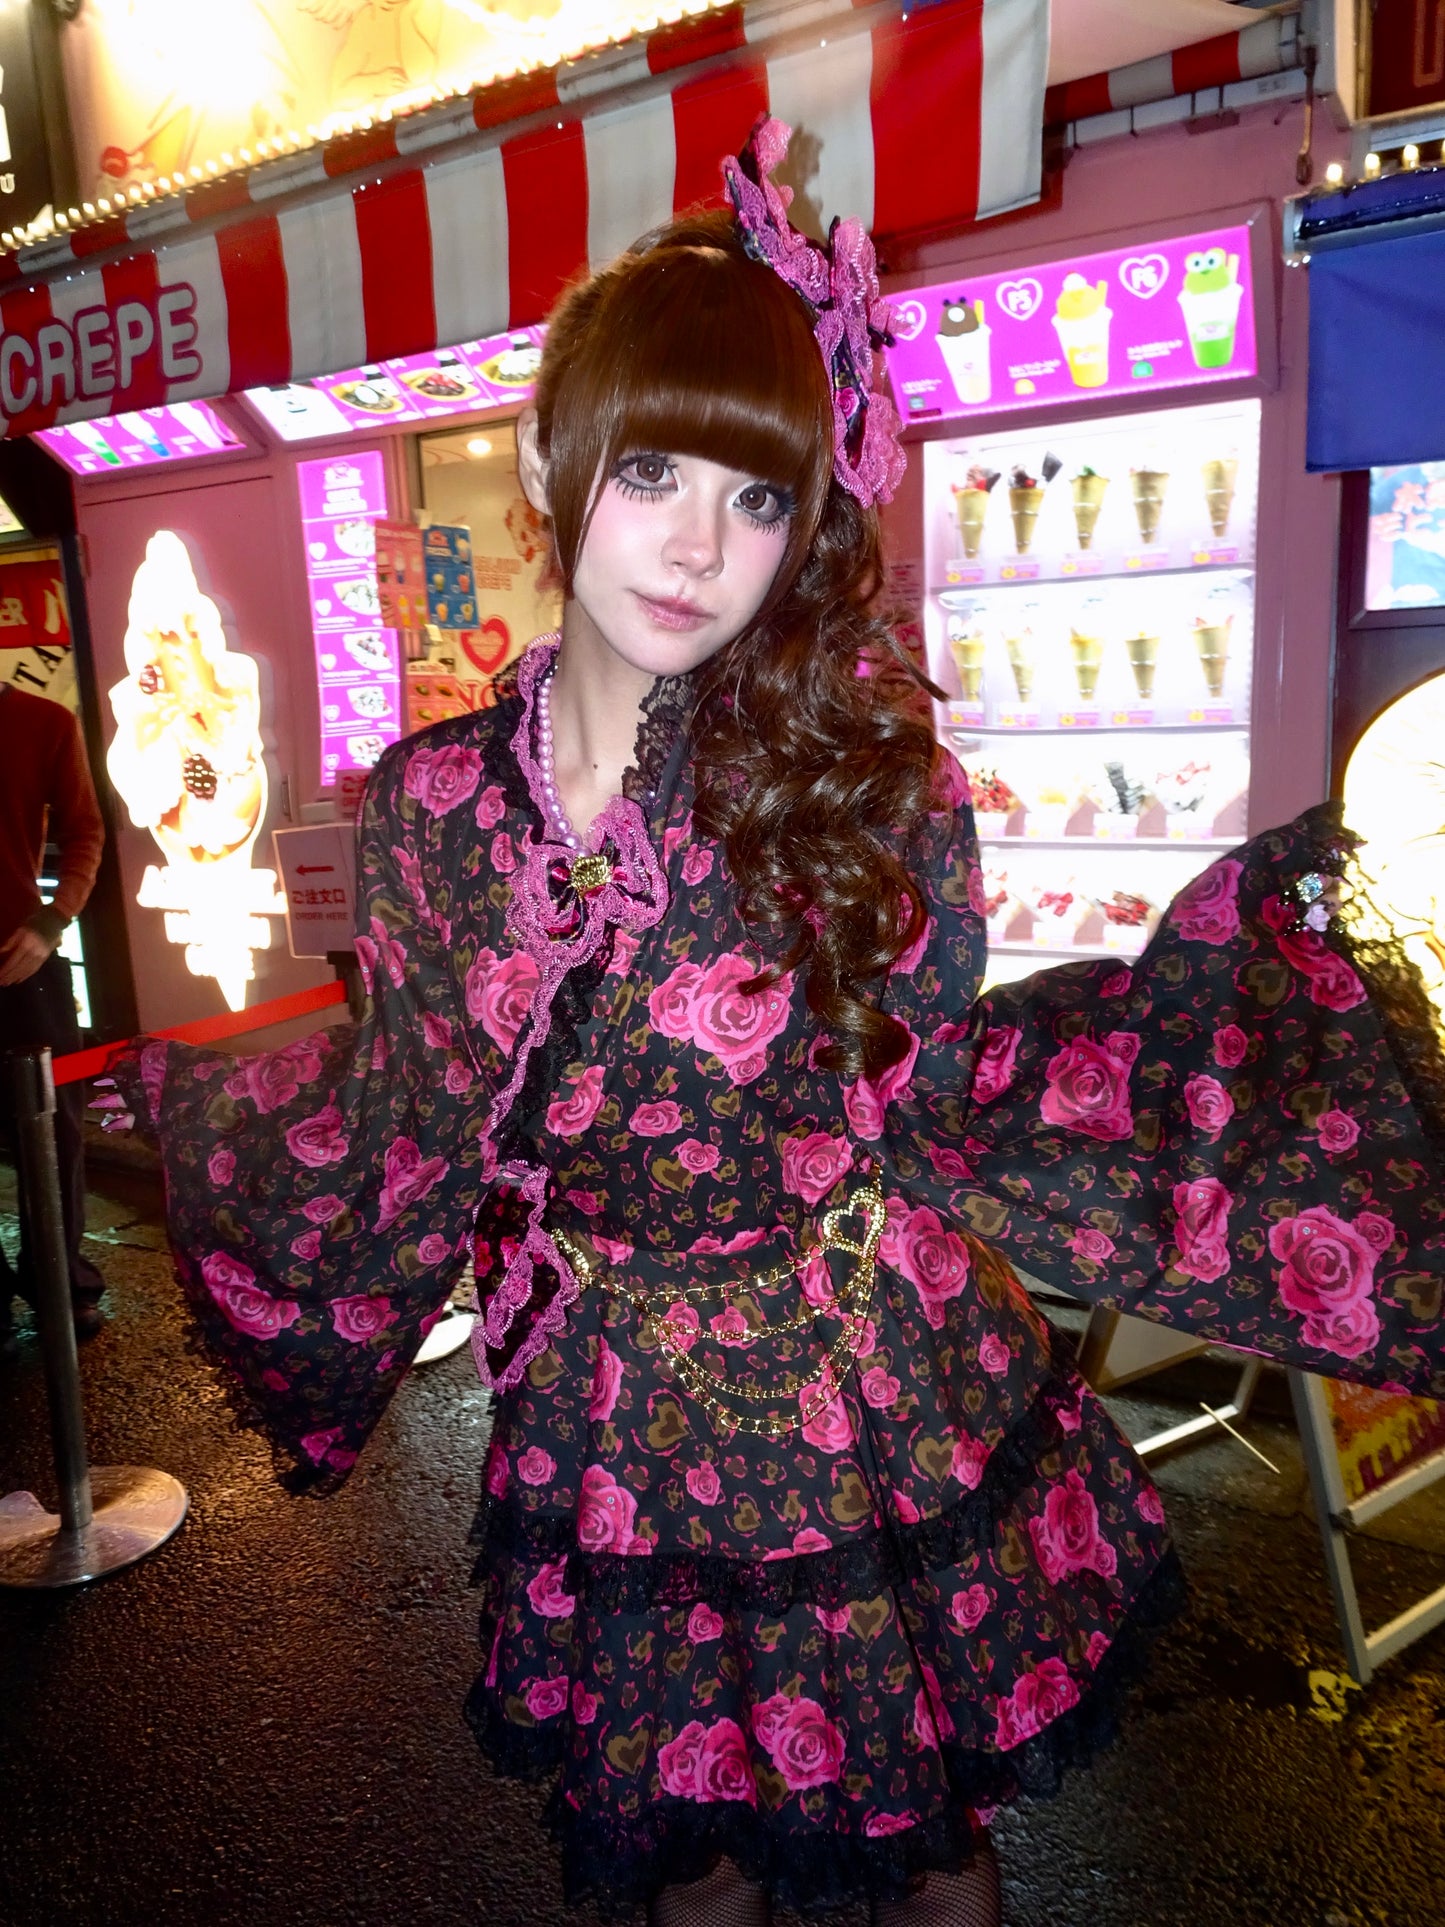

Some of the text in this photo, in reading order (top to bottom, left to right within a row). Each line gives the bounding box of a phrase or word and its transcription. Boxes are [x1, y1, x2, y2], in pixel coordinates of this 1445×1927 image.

[0, 287, 201, 415] CREPE
[295, 911, 349, 920] ORDER HERE
